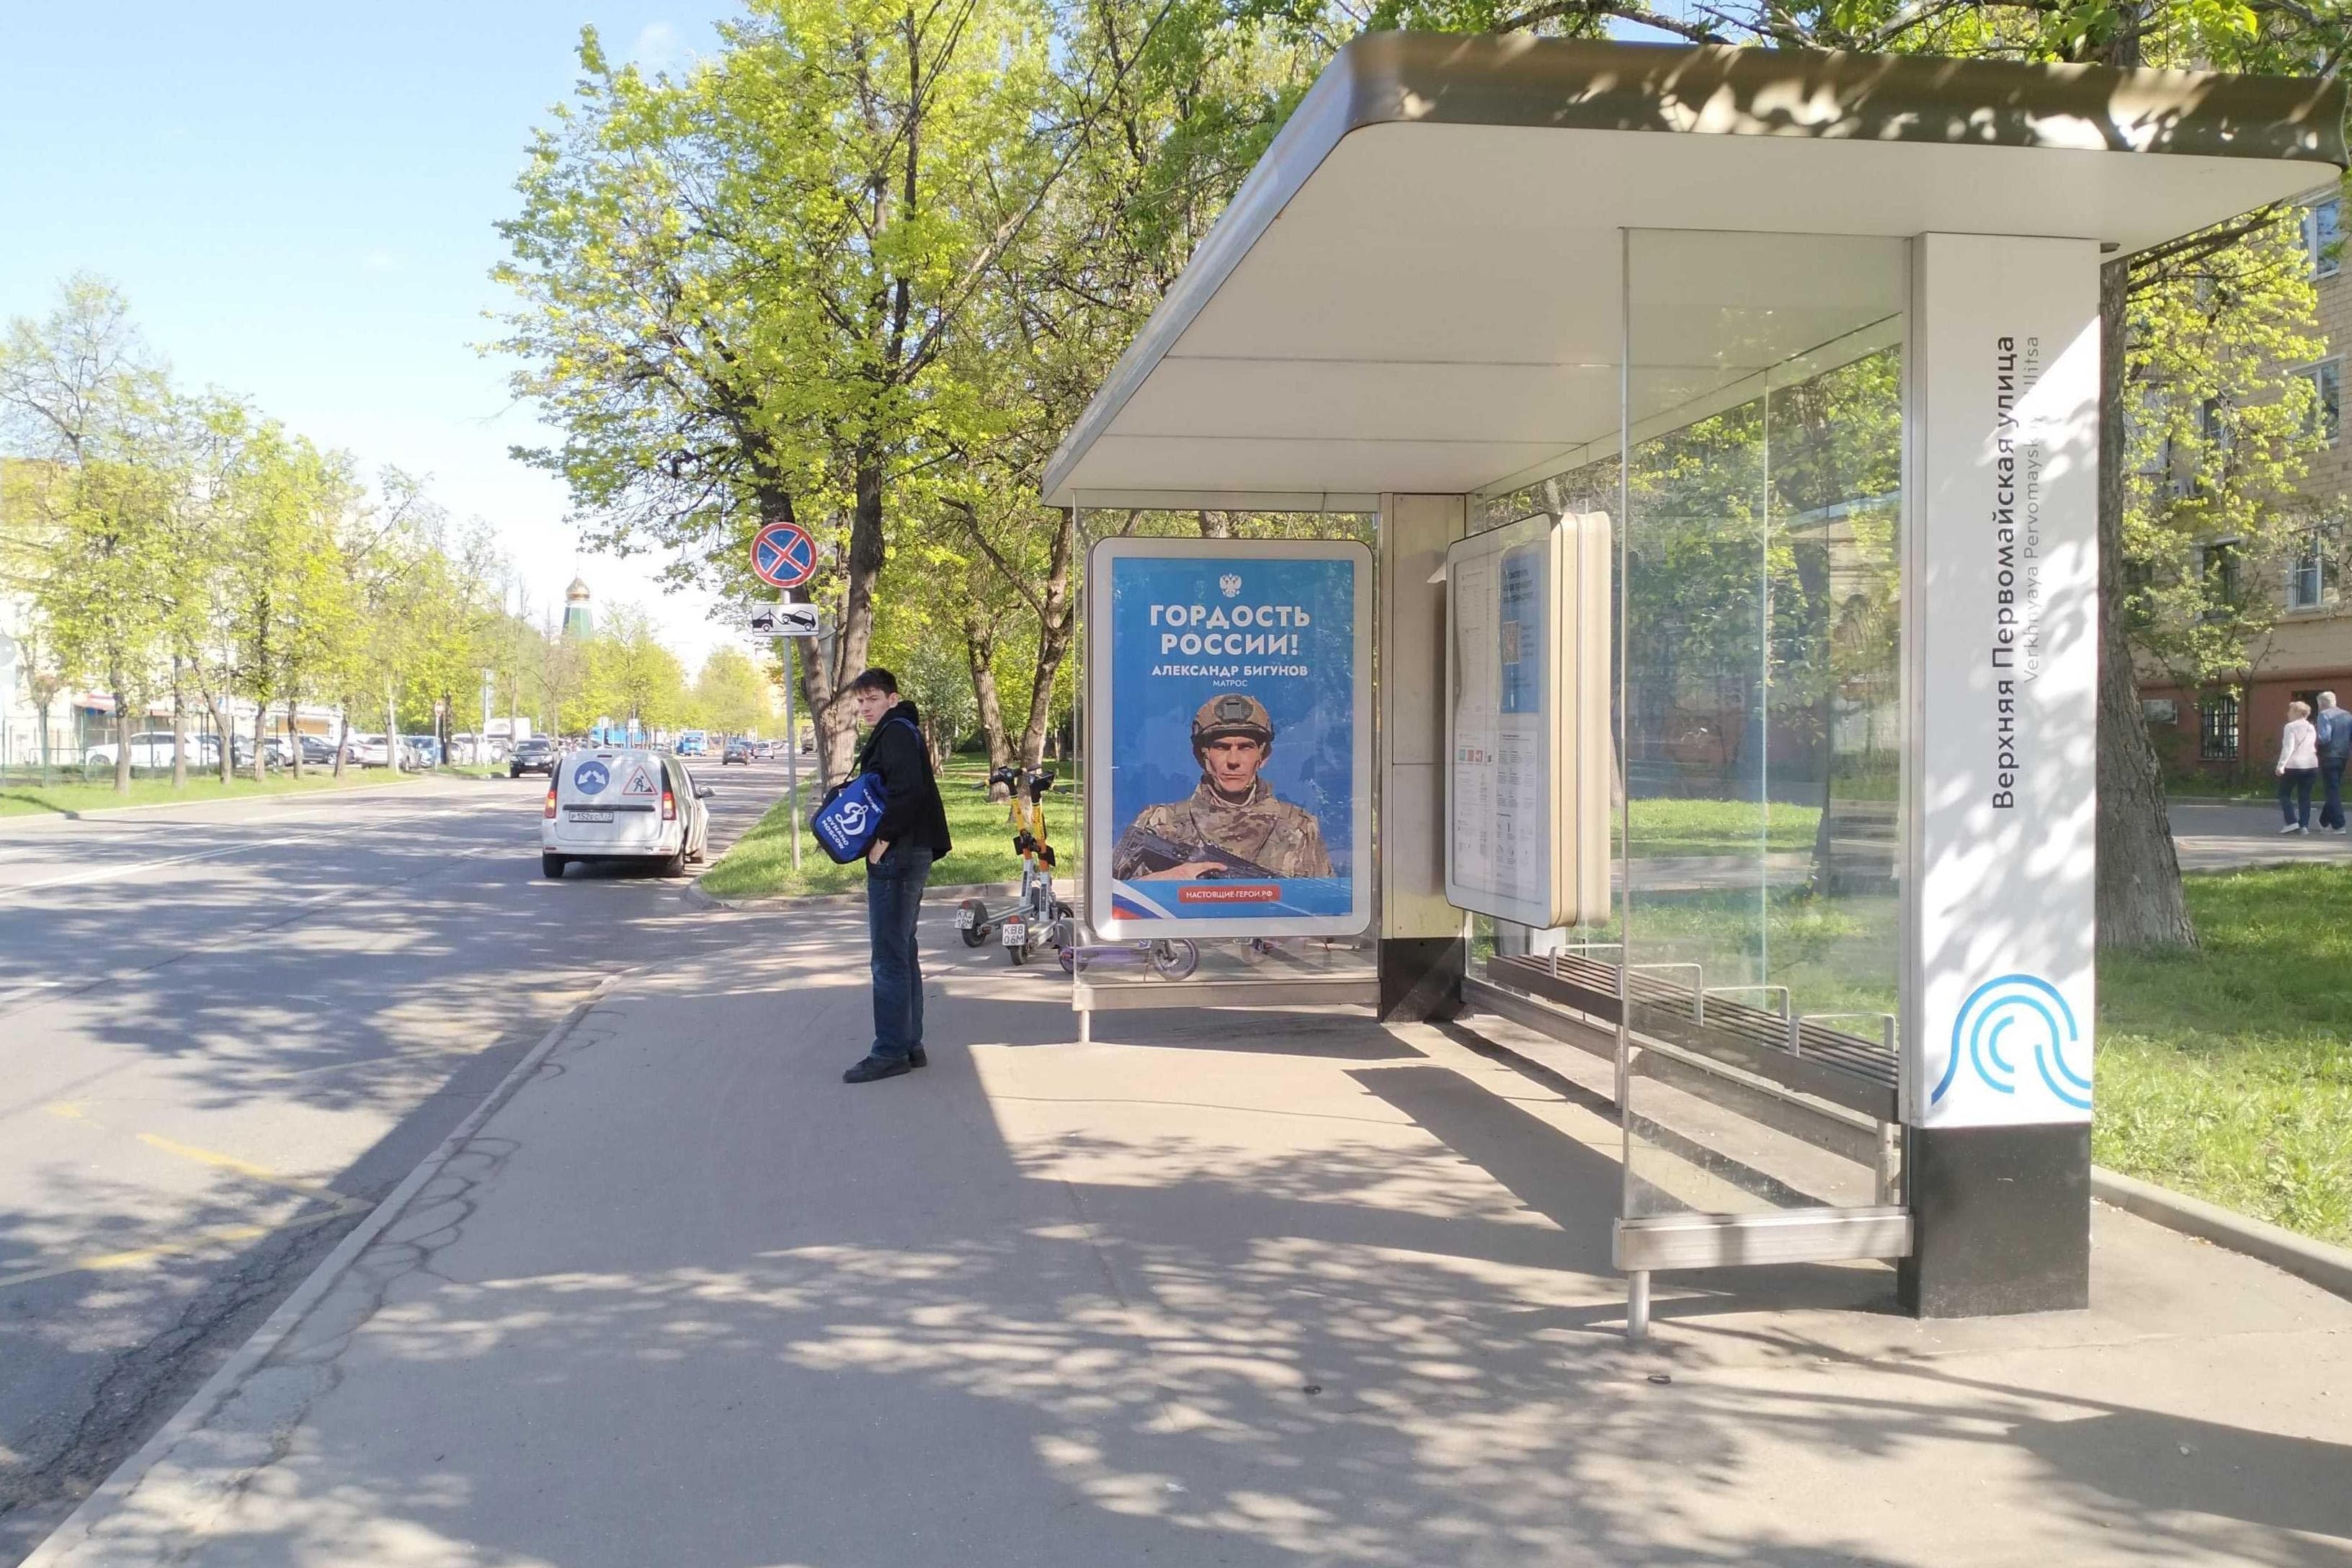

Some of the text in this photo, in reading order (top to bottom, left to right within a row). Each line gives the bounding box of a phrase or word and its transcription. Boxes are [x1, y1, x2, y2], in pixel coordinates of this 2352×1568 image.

[2023, 414, 2042, 558] Pervomaysky
[1992, 337, 2020, 809] Верхняя Первомайская улица
[1150, 605, 1310, 629] ГОРДОСТЬ
[2023, 566, 2042, 682] Verkhnyaya
[1161, 633, 1298, 656] РОССИИ!
[1152, 665, 1308, 677] АЛЕКСАНДР БИГУНОВ
[821, 819, 845, 849] MOSCOW
[827, 816, 849, 845] DYNAMO
